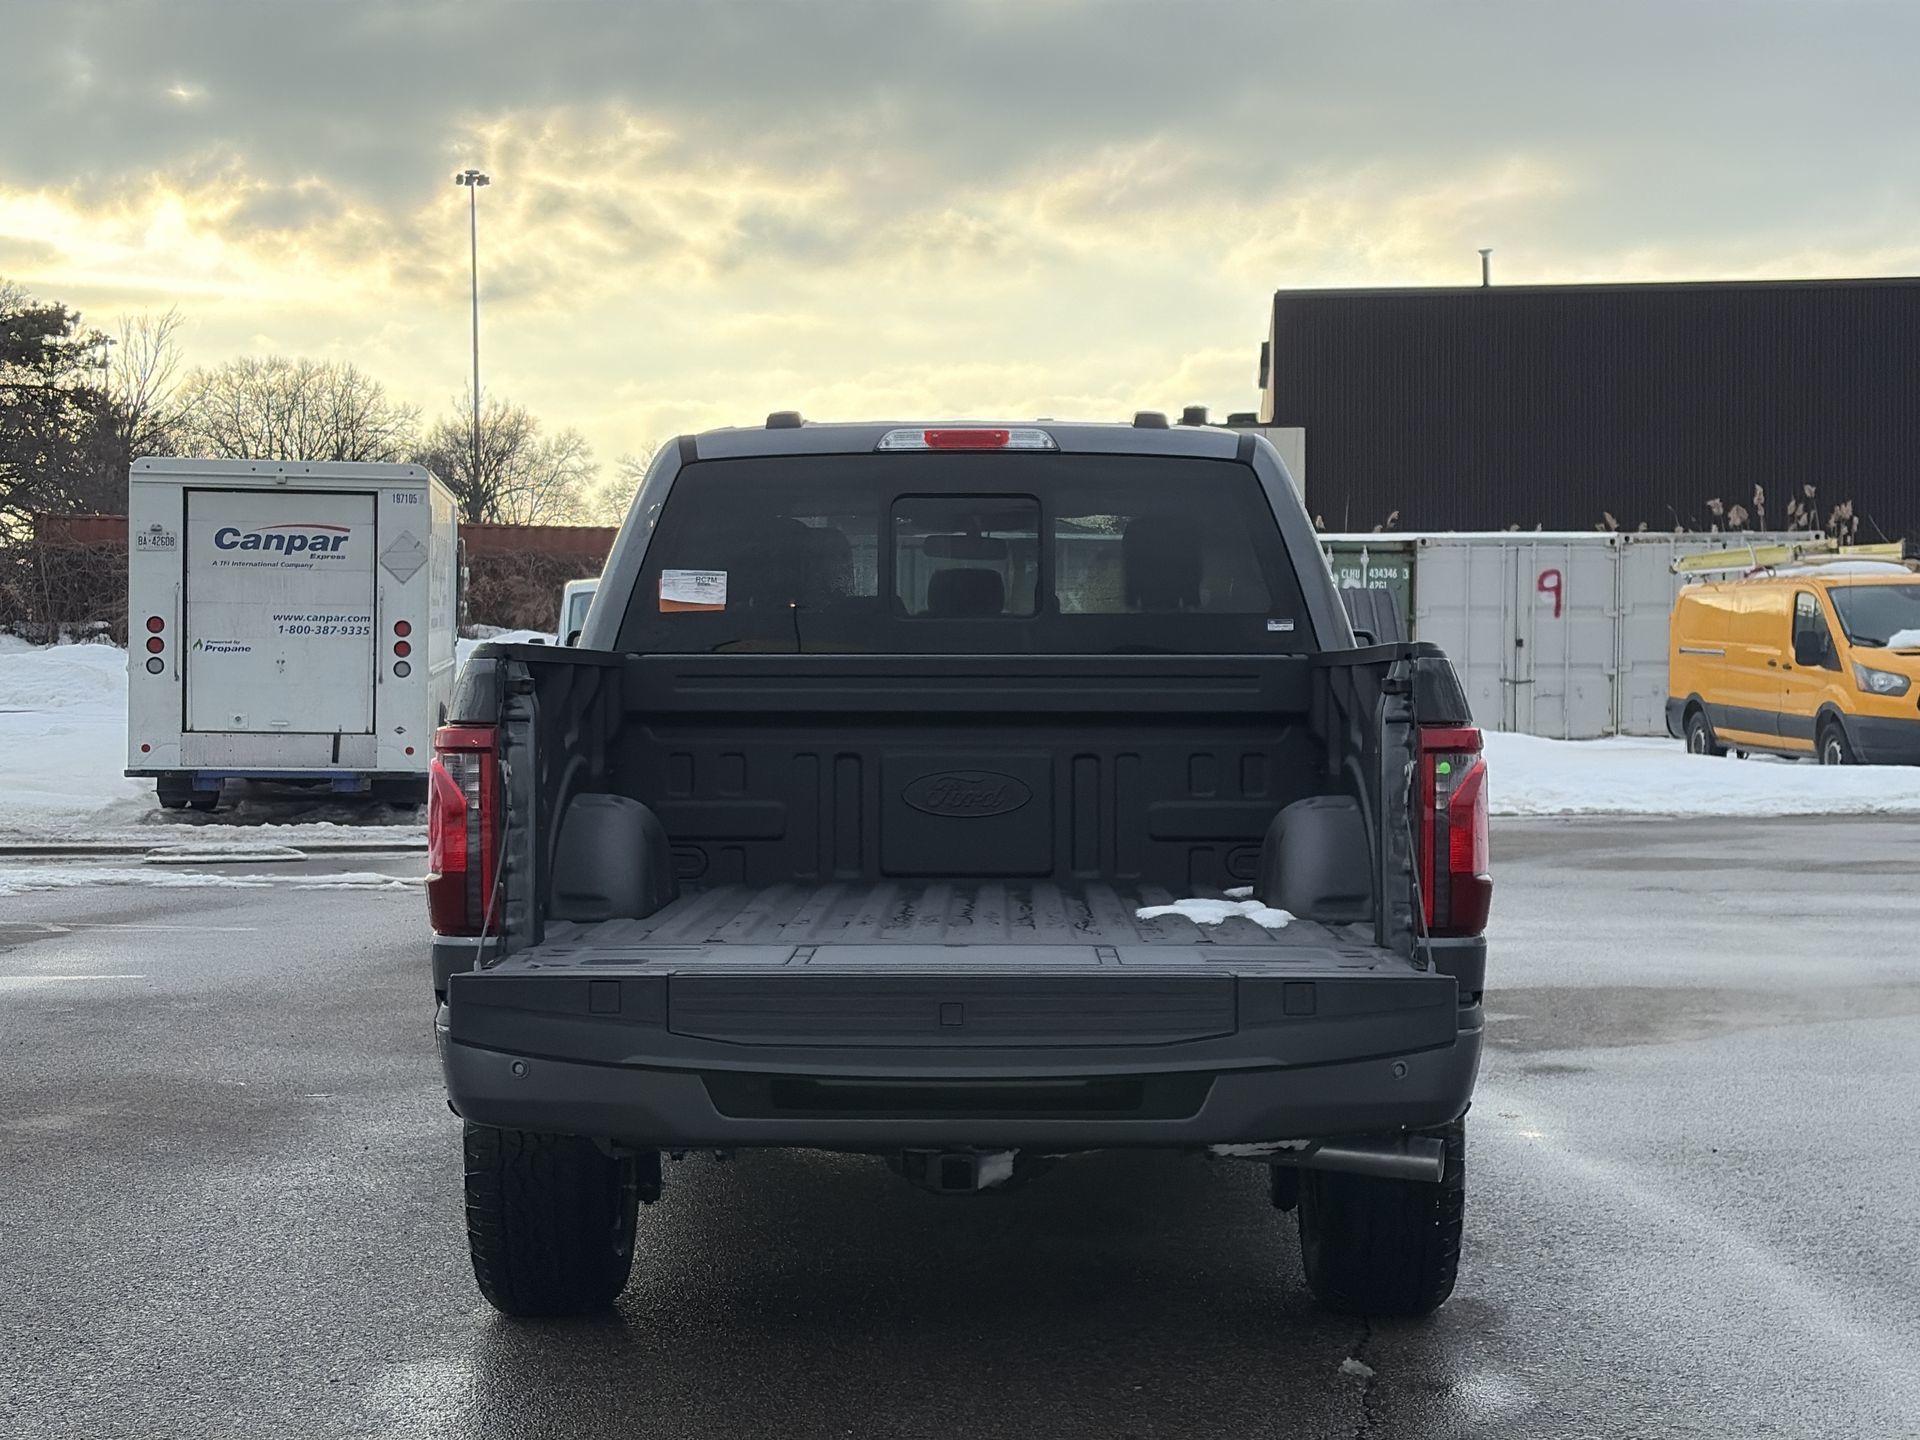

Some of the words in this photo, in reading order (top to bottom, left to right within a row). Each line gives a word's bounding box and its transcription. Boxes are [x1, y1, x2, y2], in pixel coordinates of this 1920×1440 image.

[392, 493, 418, 504] 187105
[214, 527, 349, 555] Canpar
[1369, 568, 1397, 578] 434346
[1537, 569, 1563, 618] 9
[273, 614, 371, 623] www.canpar.com
[278, 625, 370, 635] 1-800-387-9335
[204, 645, 251, 653] Propane
[926, 777, 1008, 808] Ford
